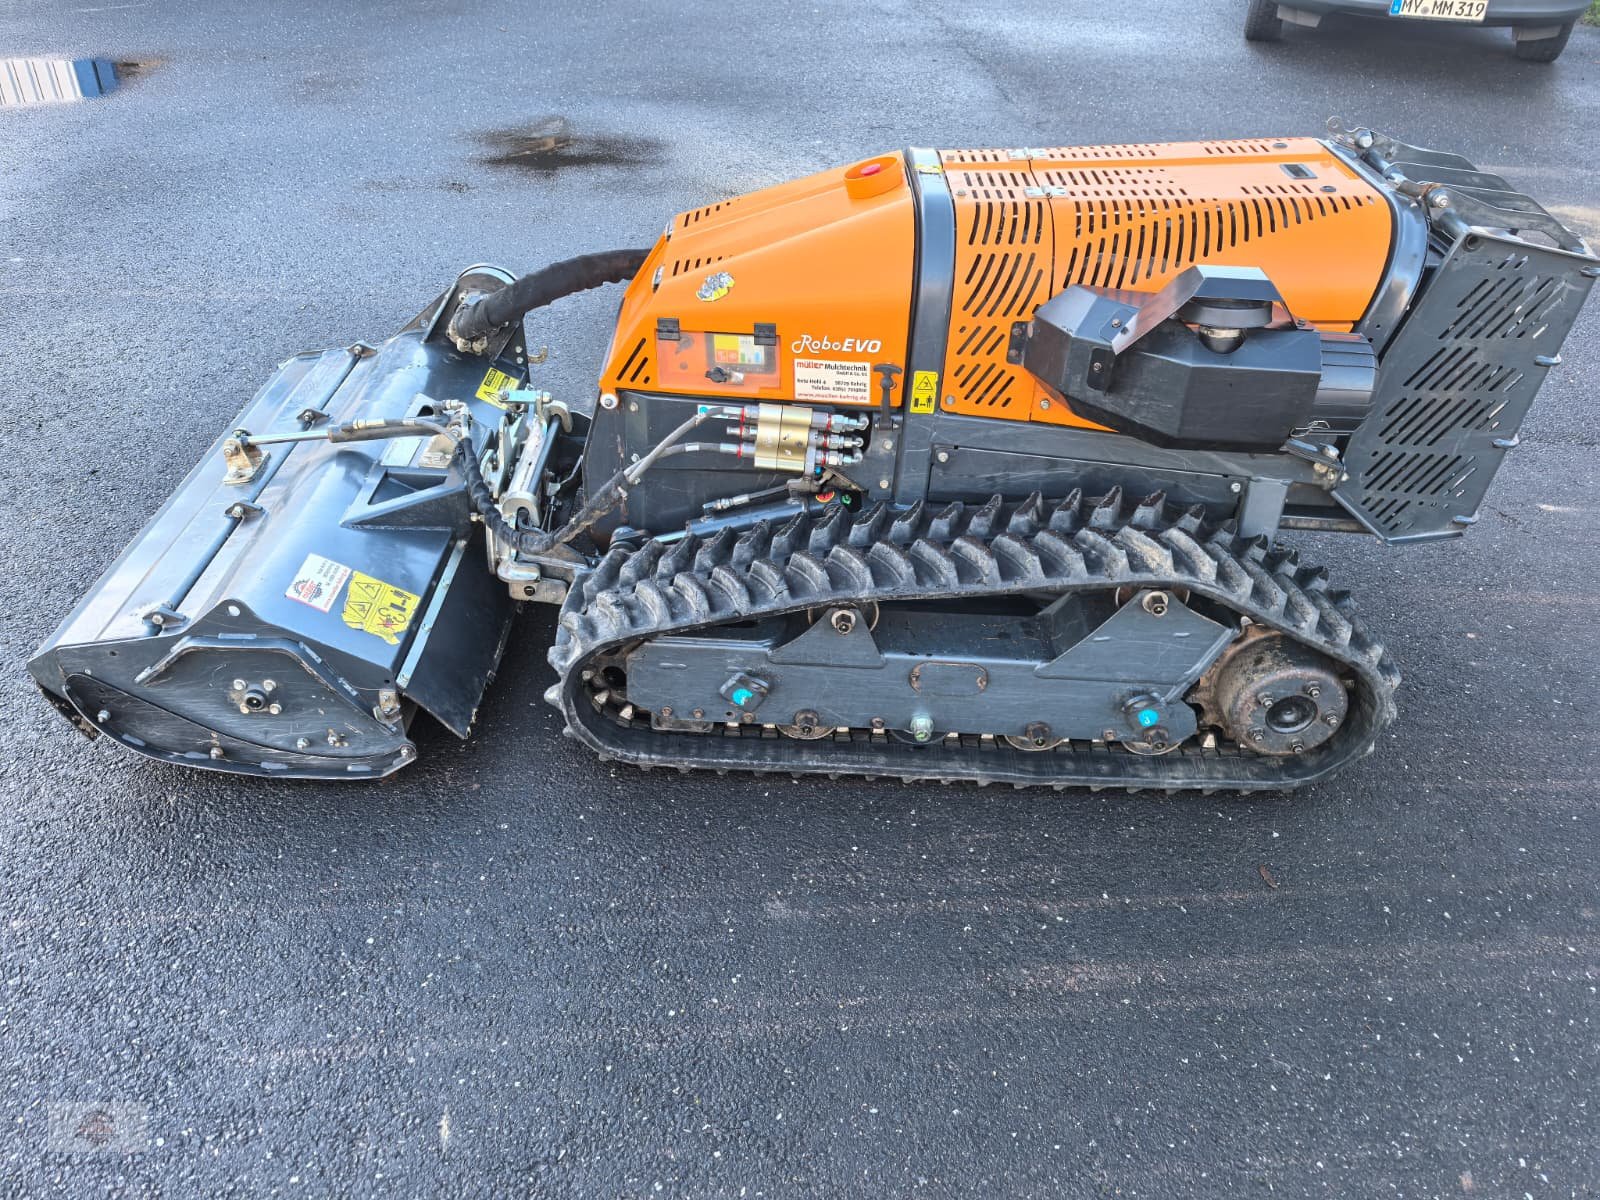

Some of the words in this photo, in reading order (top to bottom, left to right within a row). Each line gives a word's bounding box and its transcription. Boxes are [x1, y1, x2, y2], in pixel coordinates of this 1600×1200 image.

[1401, 0, 1421, 13] MY
[1431, 1, 1454, 15] MM
[1455, 2, 1485, 17] 319
[791, 334, 882, 354] RoboEVO
[796, 361, 824, 369] müller
[824, 363, 868, 372] Mulchtechnik
